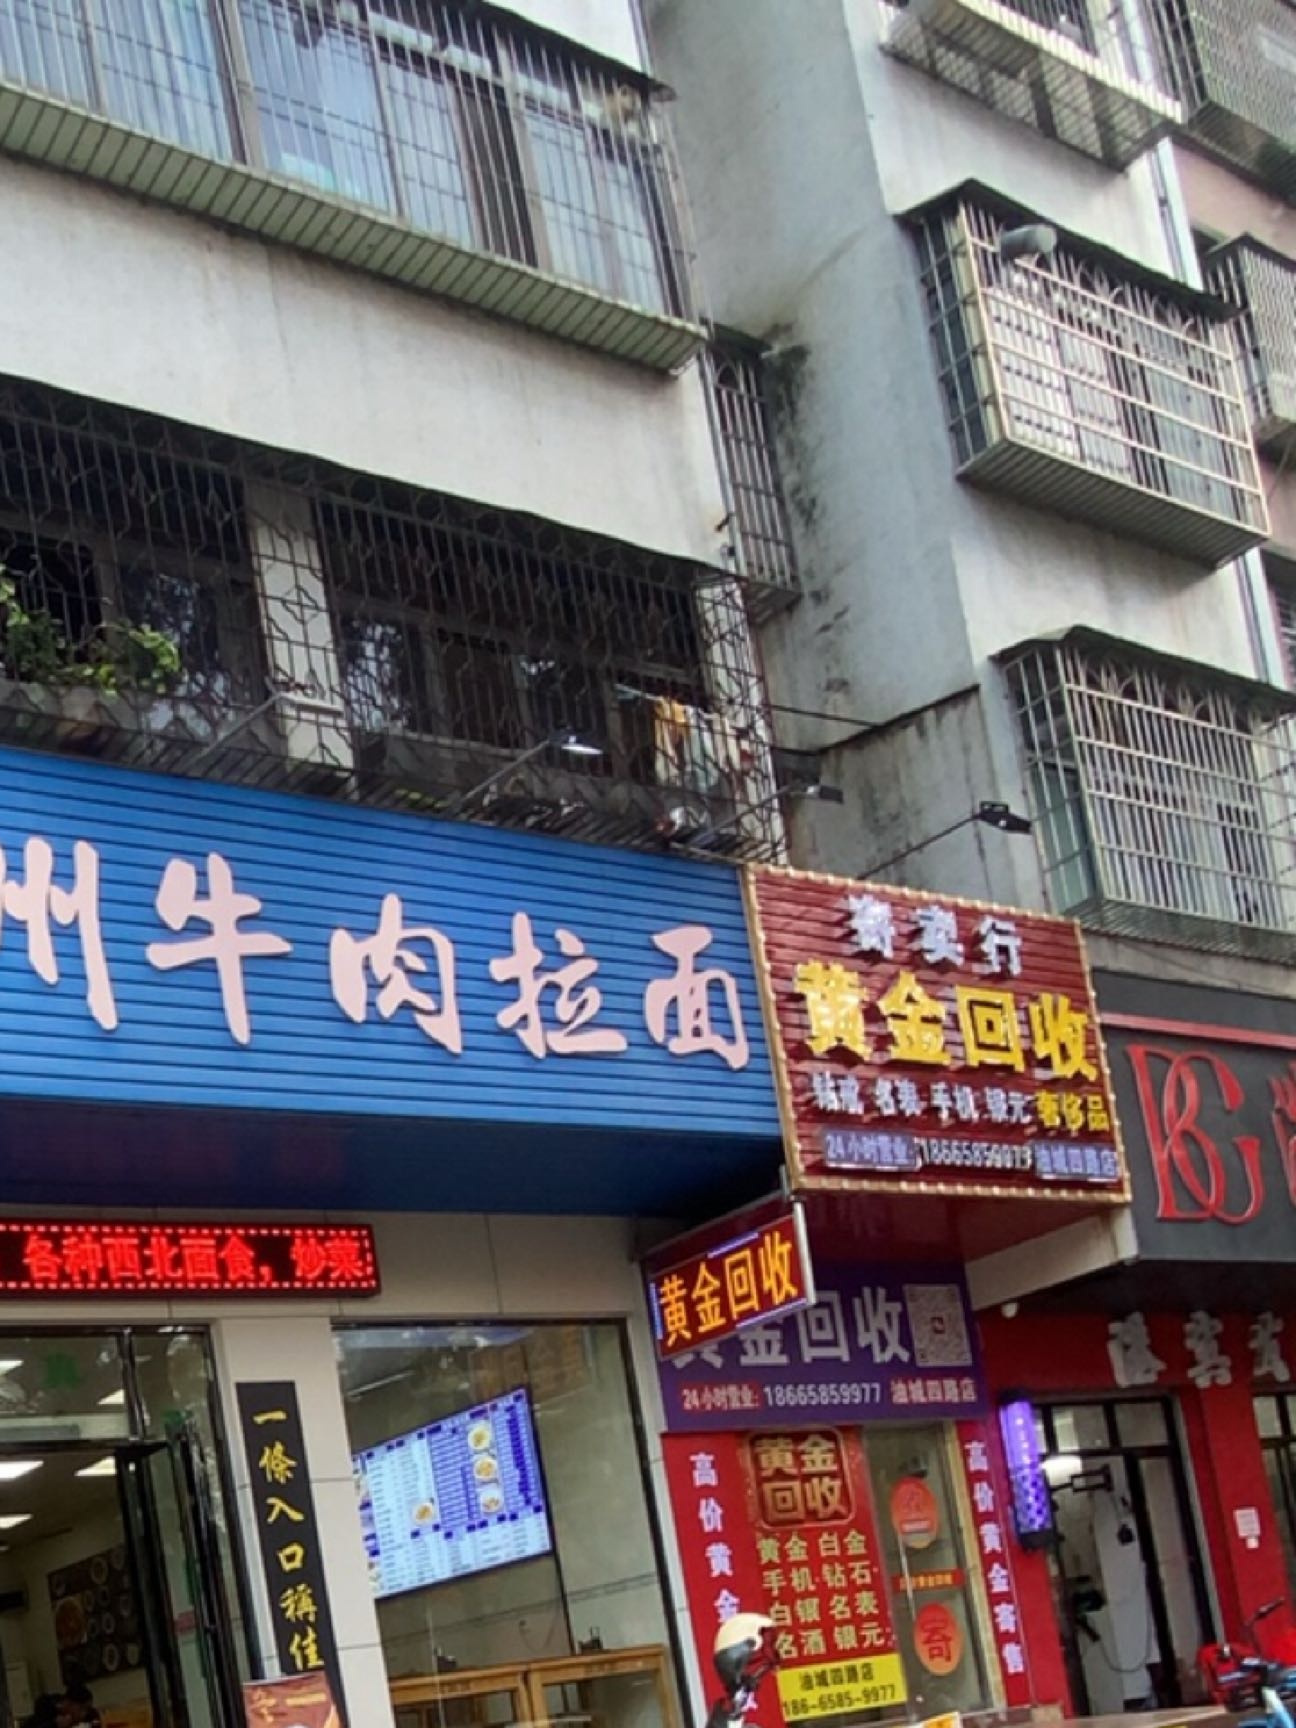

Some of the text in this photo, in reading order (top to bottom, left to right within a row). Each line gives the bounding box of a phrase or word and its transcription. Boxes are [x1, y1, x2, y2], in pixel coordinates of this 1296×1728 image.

[793, 959, 1098, 1081] 黄金回收
[659, 1230, 799, 1348] 黄金回收
[673, 1286, 911, 1369] 金回收
[763, 1382, 881, 1407] 18665859977
[756, 1434, 838, 1476] 黄金
[761, 1476, 847, 1521] 回收
[757, 1529, 867, 1564] 黄金 白金
[689, 1452, 758, 1713] 高价黄金
